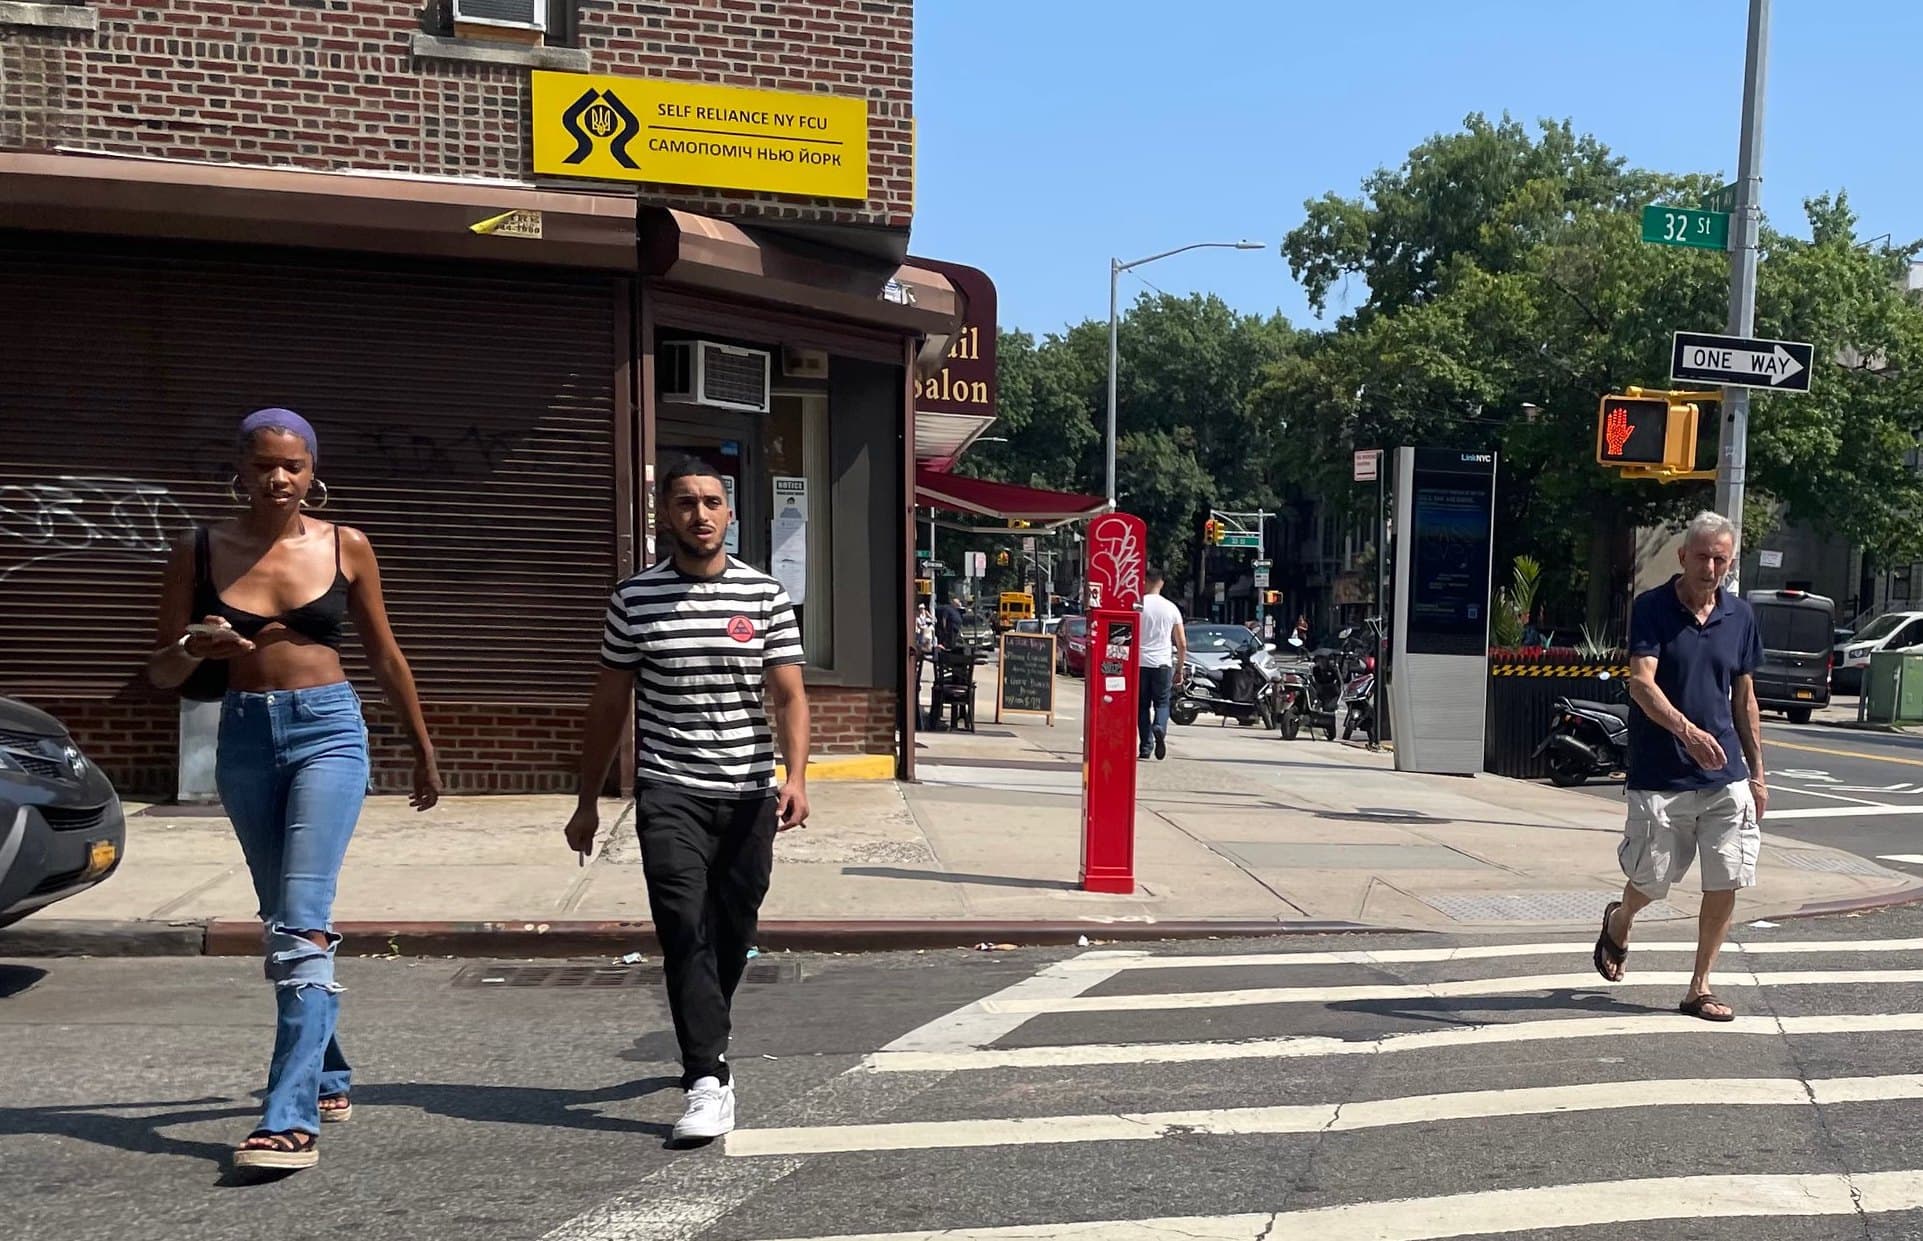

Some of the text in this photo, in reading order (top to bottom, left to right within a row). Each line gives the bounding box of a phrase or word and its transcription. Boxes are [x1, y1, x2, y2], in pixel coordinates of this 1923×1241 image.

[658, 103, 828, 130] SELF RELIANCE NY FCU
[648, 138, 841, 167] САМОПОМІЧ НЬЮ ЙОРК
[1664, 213, 1711, 241] 32 St
[947, 327, 979, 360] il
[1694, 349, 1791, 375] ONE WAY
[1461, 453, 1491, 463] LinkNYC
[777, 481, 803, 490] NOTICE
